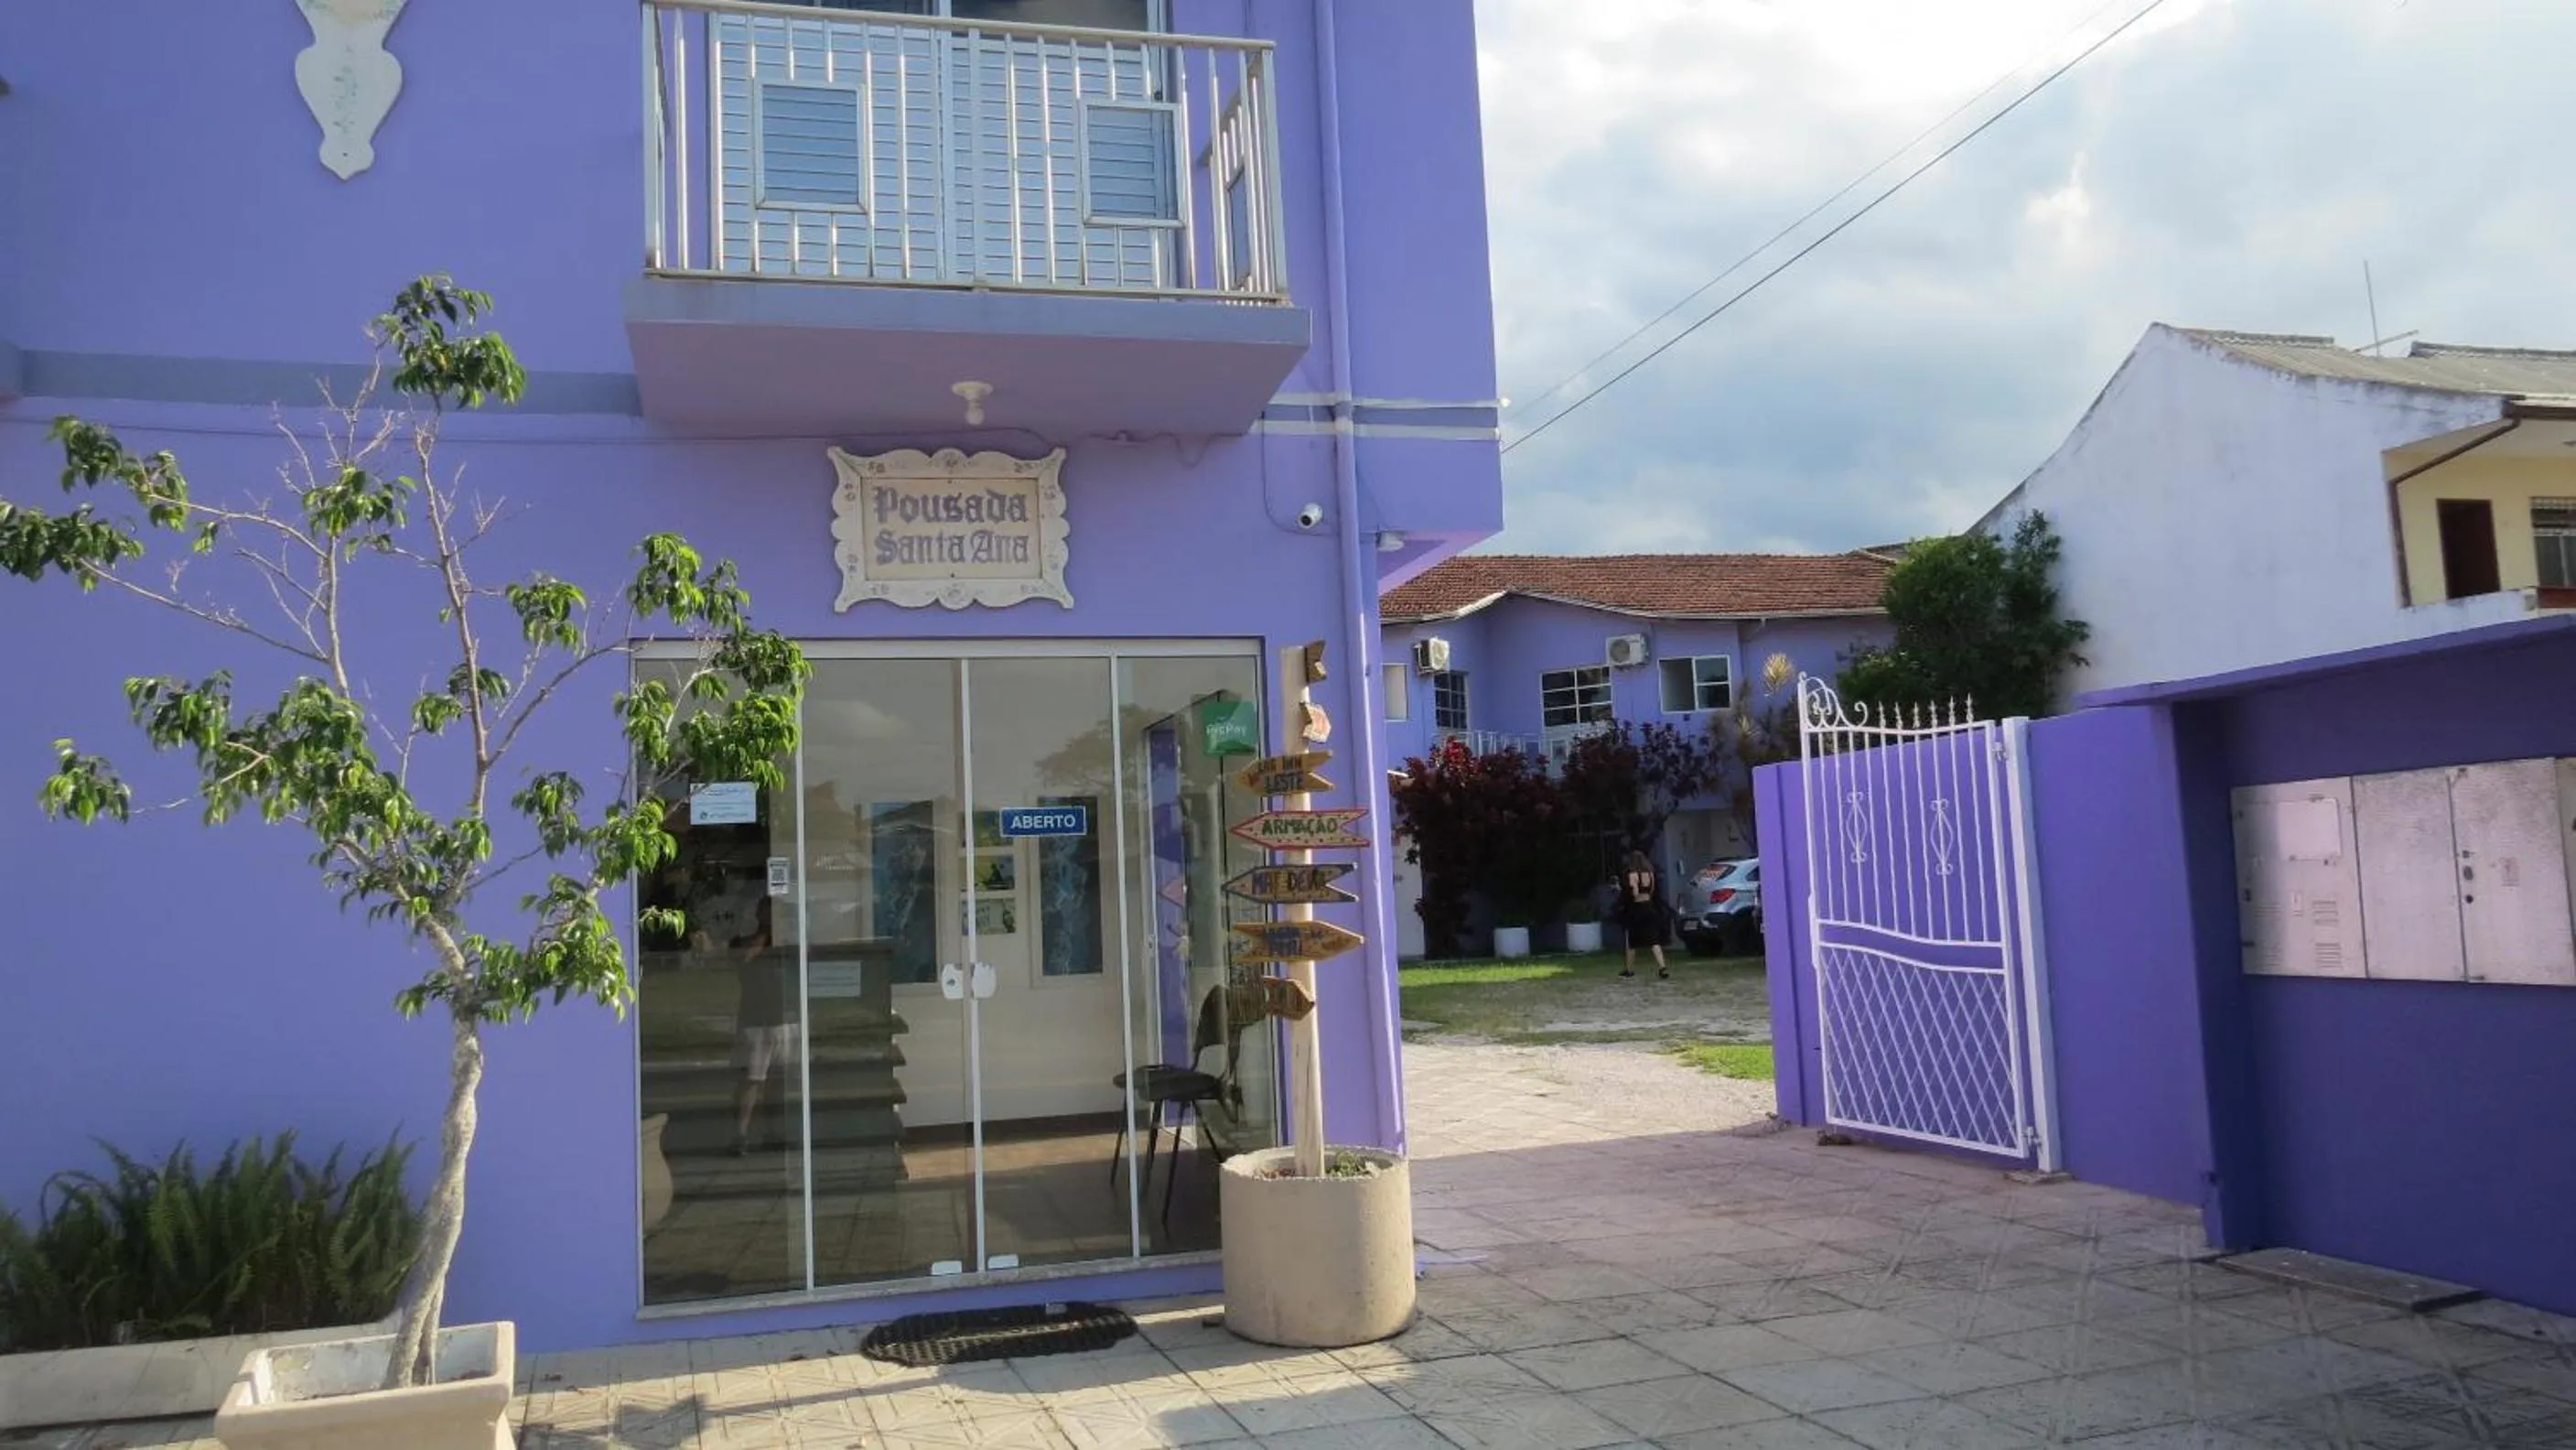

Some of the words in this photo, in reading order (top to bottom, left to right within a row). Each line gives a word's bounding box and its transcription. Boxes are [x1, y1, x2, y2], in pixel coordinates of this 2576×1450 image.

[873, 486, 1029, 524] Pousada
[874, 528, 965, 566] Santa
[970, 529, 1029, 565] Ana
[1010, 814, 1076, 829] ABERTO
